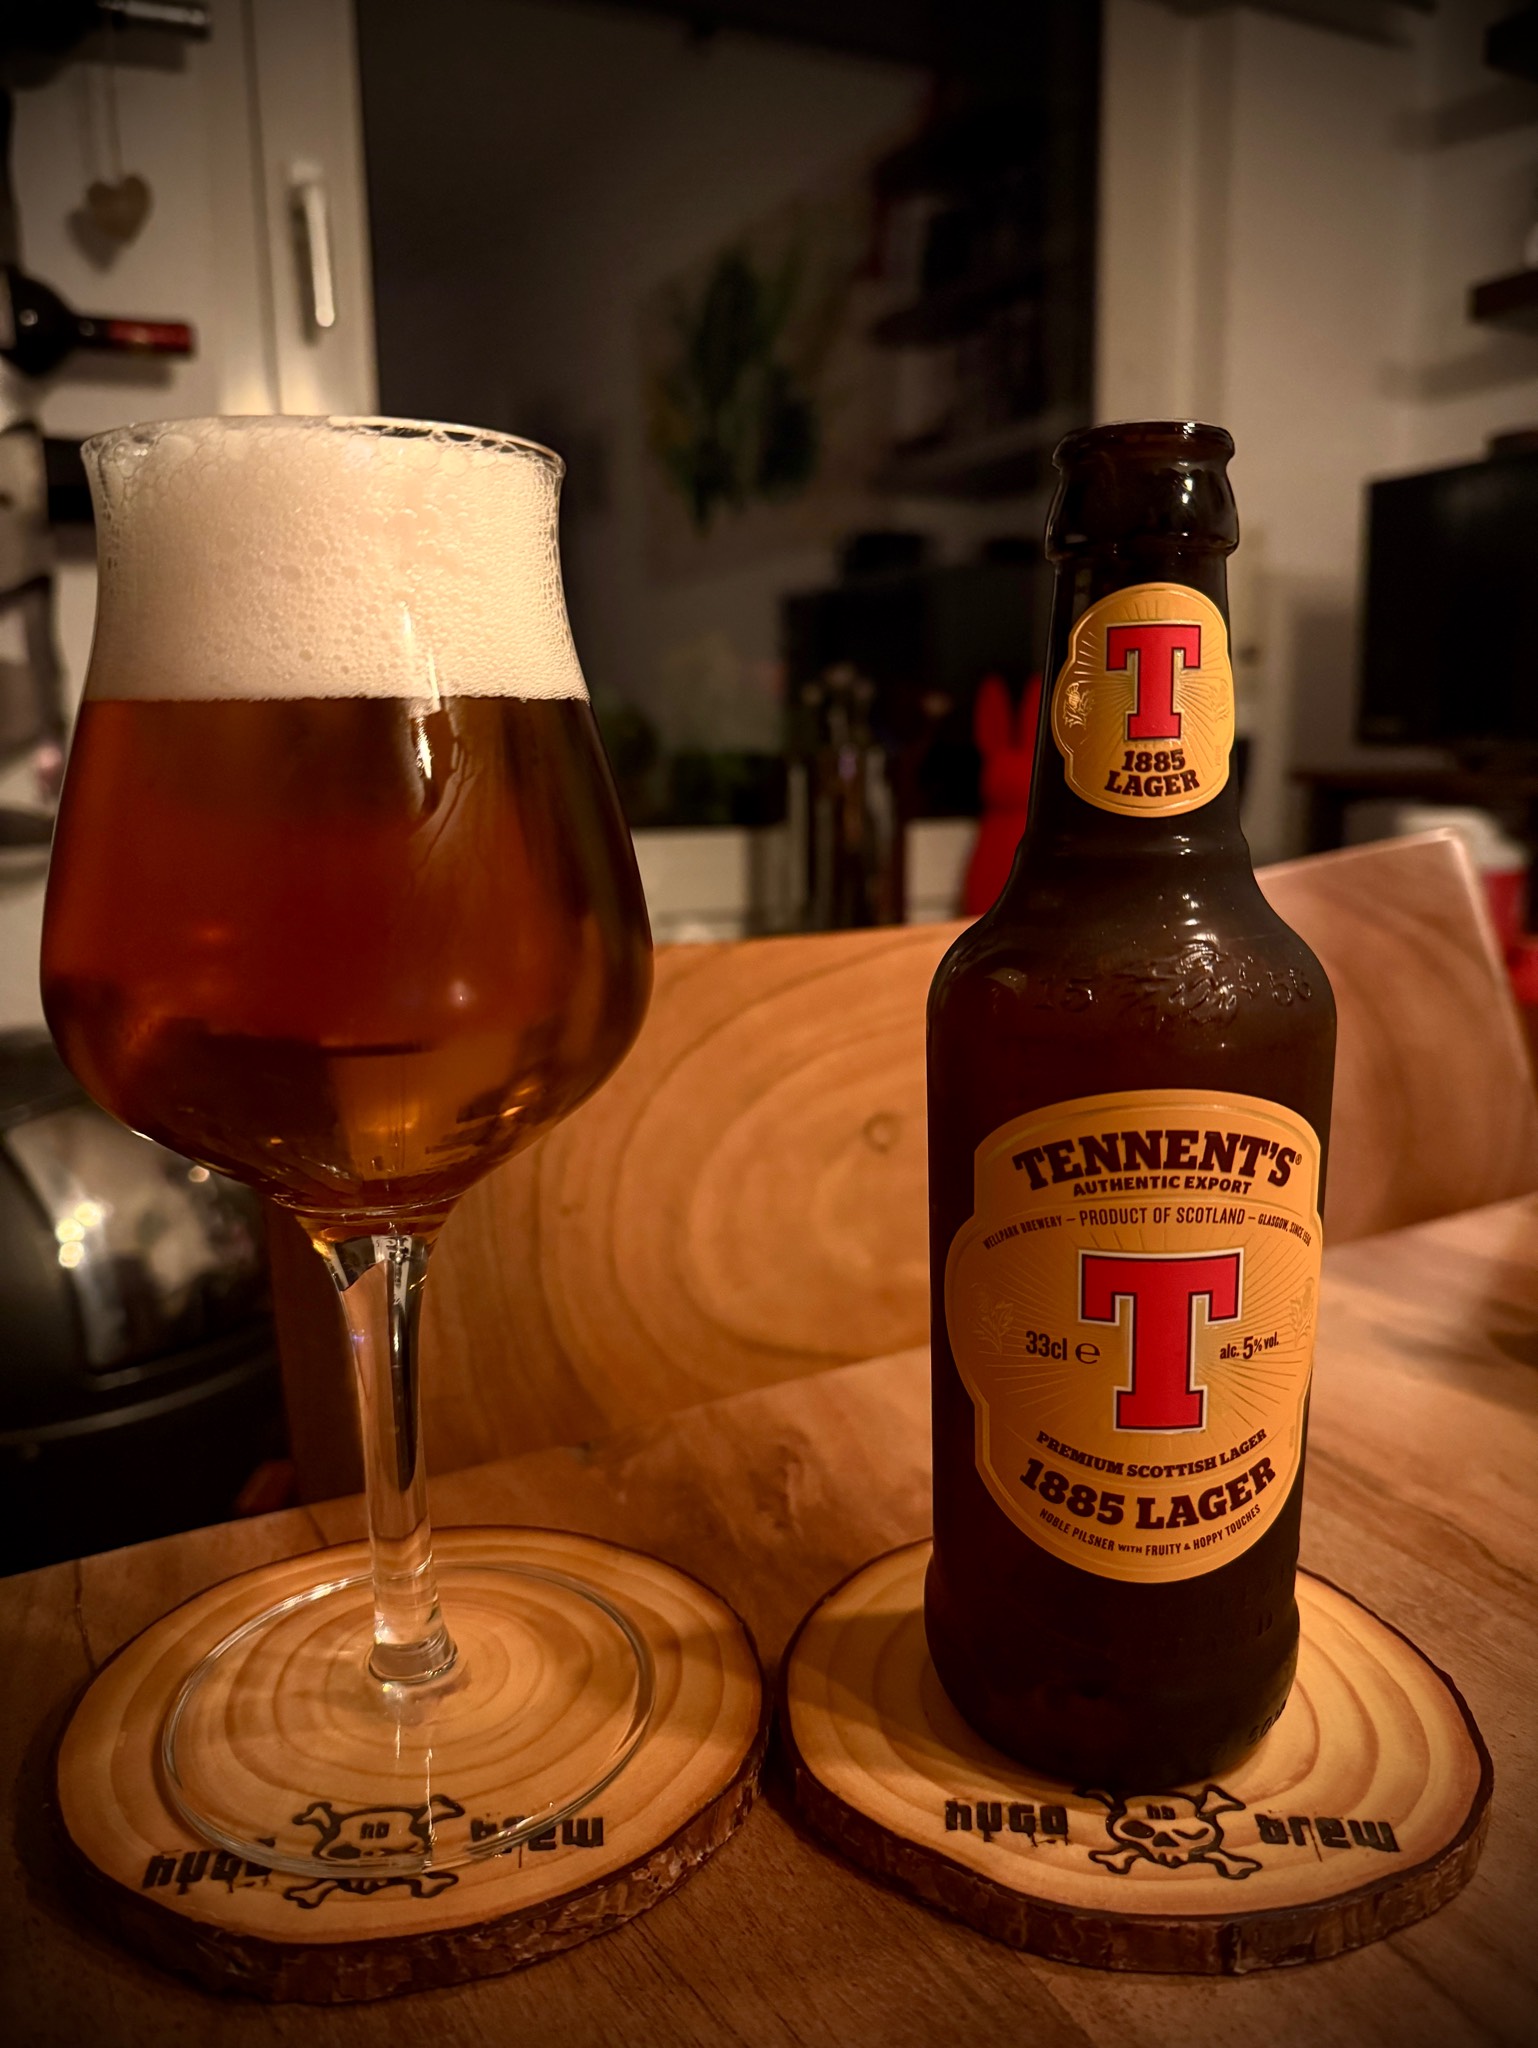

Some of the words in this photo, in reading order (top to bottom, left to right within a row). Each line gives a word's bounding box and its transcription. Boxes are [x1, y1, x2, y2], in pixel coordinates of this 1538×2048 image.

[1106, 621, 1202, 741] T
[1121, 749, 1186, 773] 1885
[1104, 769, 1200, 797] LAGER
[1011, 1129, 1297, 1190] TENNENT'S
[1073, 1175, 1180, 1197] AUTHENTIC
[1184, 1175, 1252, 1195] EXPORT
[1020, 1215, 1062, 1234] BREWERY
[1079, 1207, 1148, 1226] PRODUCT
[1152, 1206, 1171, 1224] OF
[1175, 1206, 1245, 1225] SCOTLAND
[1026, 1330, 1067, 1361] 33cl
[1078, 1247, 1245, 1432] T
[1219, 1343, 1240, 1360] alc.
[1263, 1331, 1279, 1350] vol.
[1036, 1430, 1124, 1475] PREMIUM
[1126, 1456, 1217, 1478] SCOTTISH
[1219, 1428, 1268, 1465] LAGER
[1019, 1458, 1124, 1525] 1885
[1136, 1457, 1277, 1529] LAGER
[1039, 1508, 1072, 1534] NOBLE
[1071, 1527, 1115, 1551] PILSNER
[1117, 1543, 1143, 1554] WITH
[1145, 1543, 1181, 1556] FRUITY
[1193, 1529, 1223, 1550] HOPPY
[1225, 1503, 1261, 1536] TOUCHES
